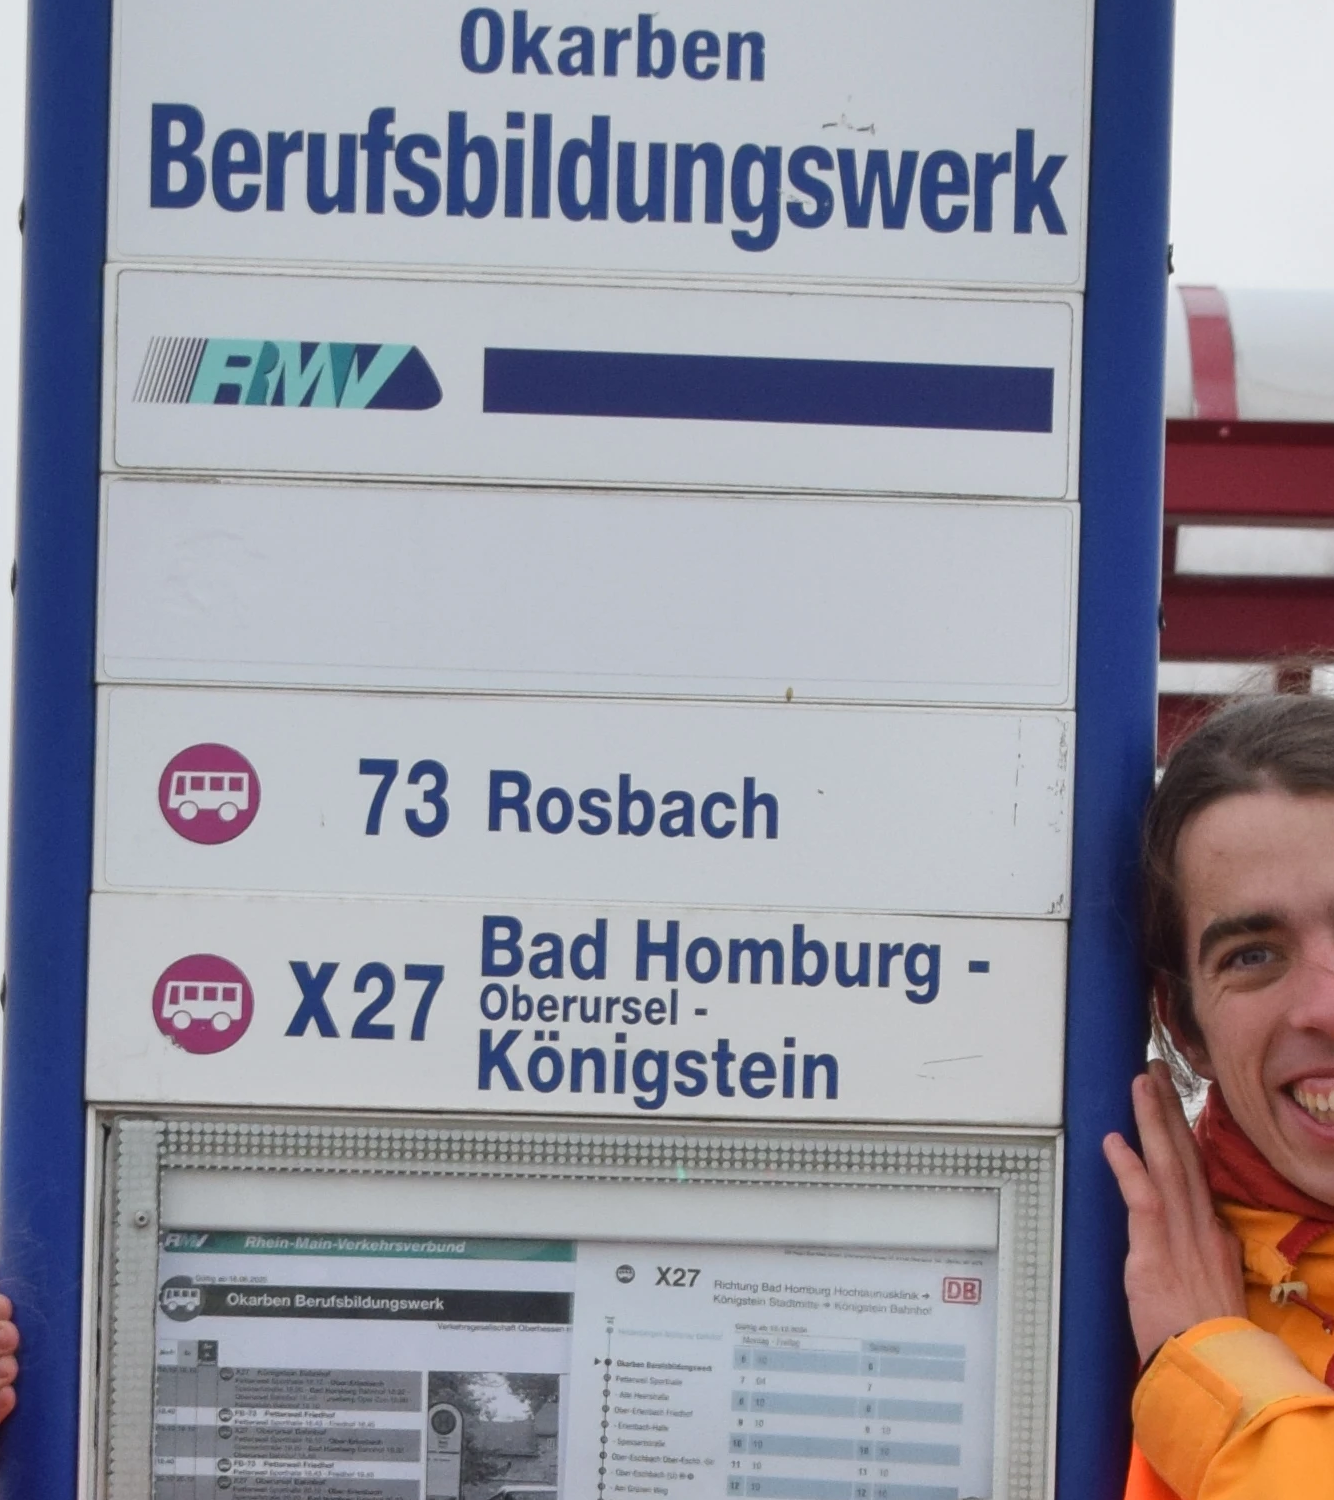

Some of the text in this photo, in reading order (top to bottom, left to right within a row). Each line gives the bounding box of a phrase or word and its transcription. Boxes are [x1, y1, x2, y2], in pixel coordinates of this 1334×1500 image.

[461, 7, 766, 82] Okarben
[149, 103, 1068, 252] Berufsbildungswerk
[358, 758, 779, 840] 73 Rosbach
[480, 915, 608, 980] Bad
[636, 919, 941, 1005] Homburg
[285, 960, 445, 1041] X27
[479, 989, 679, 1024] Oberursel
[477, 1027, 840, 1109] Königstein
[245, 1236, 466, 1253] Rhein-Main-Verkehrsverbund
[655, 1266, 701, 1287] X27
[714, 1279, 759, 1293] Richtung
[761, 1282, 782, 1293] Bad
[784, 1283, 831, 1297] Homburg
[946, 1281, 978, 1301] DB
[227, 1293, 445, 1312] Okarben Berufsbildungswerk
[713, 1293, 766, 1307] Königstein
[834, 1302, 887, 1314] Königstein
[890, 1303, 933, 1315] Bahnhof
